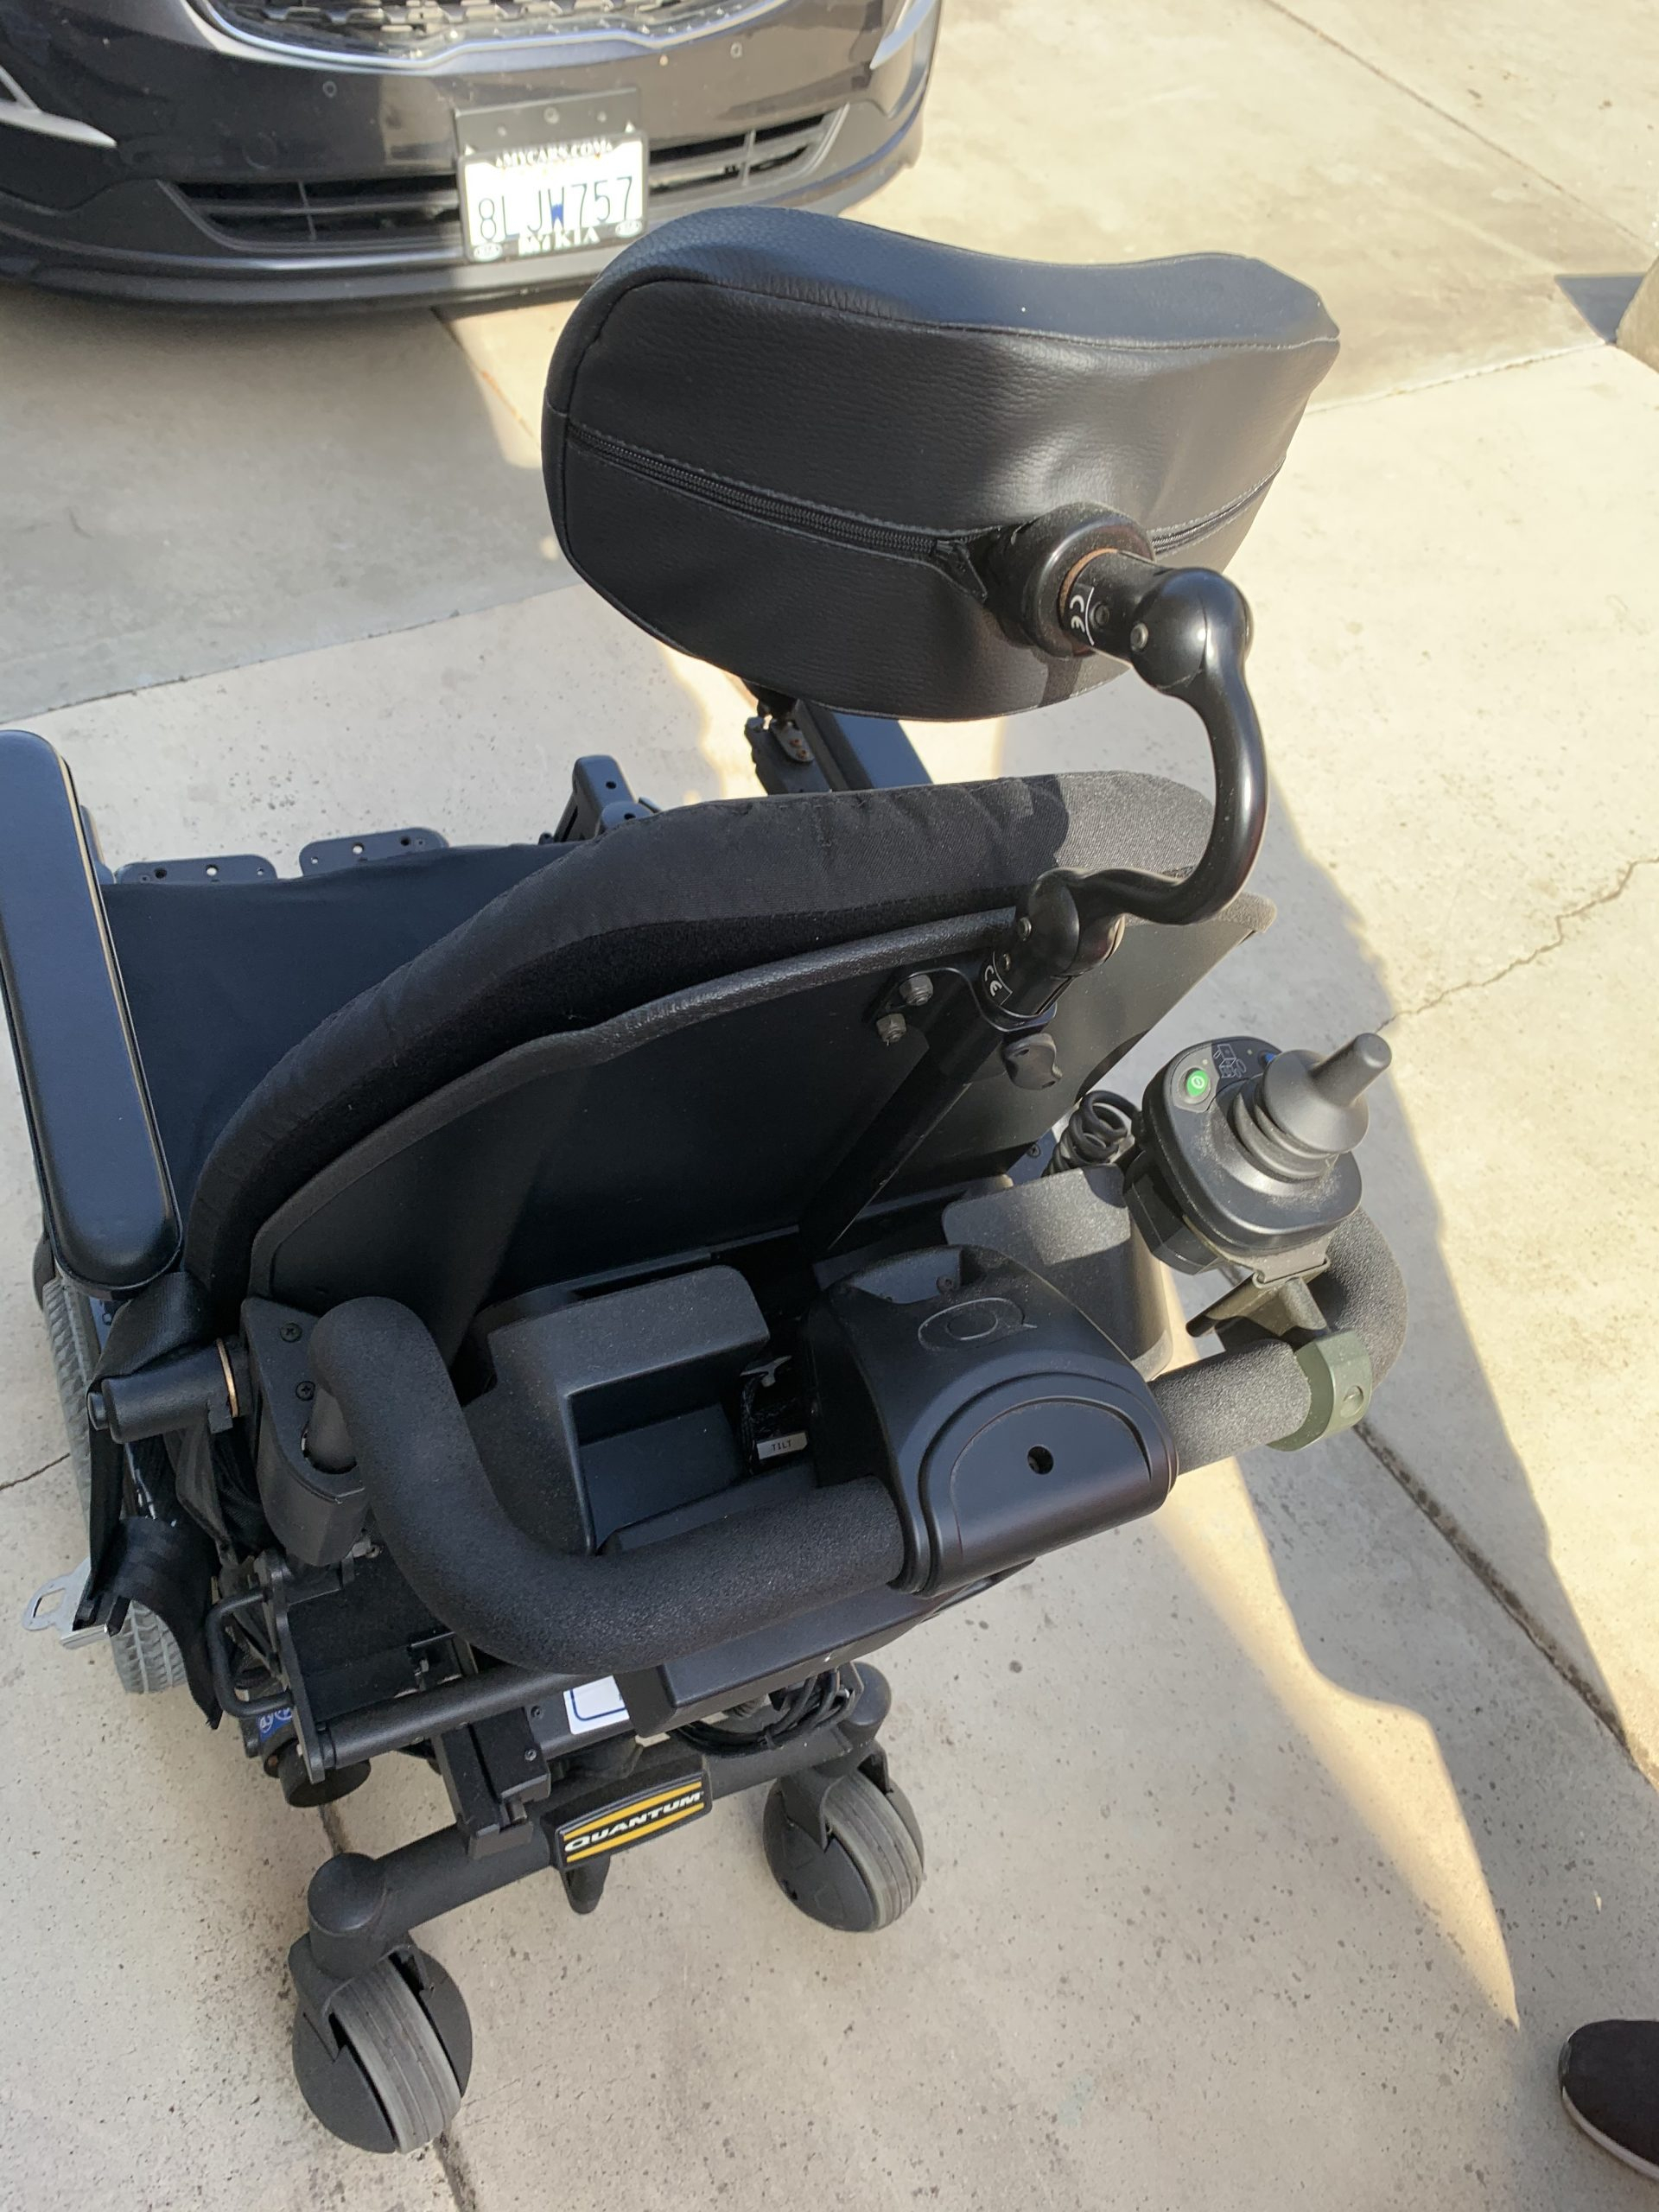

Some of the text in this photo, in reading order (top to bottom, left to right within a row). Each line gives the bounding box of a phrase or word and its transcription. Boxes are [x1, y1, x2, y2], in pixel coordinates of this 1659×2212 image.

[553, 225, 601, 251] KIA
[1069, 594, 1086, 632] CE
[984, 964, 1003, 996] CE
[771, 1439, 792, 1452] TILT
[564, 1791, 702, 1853] QUANTUM
